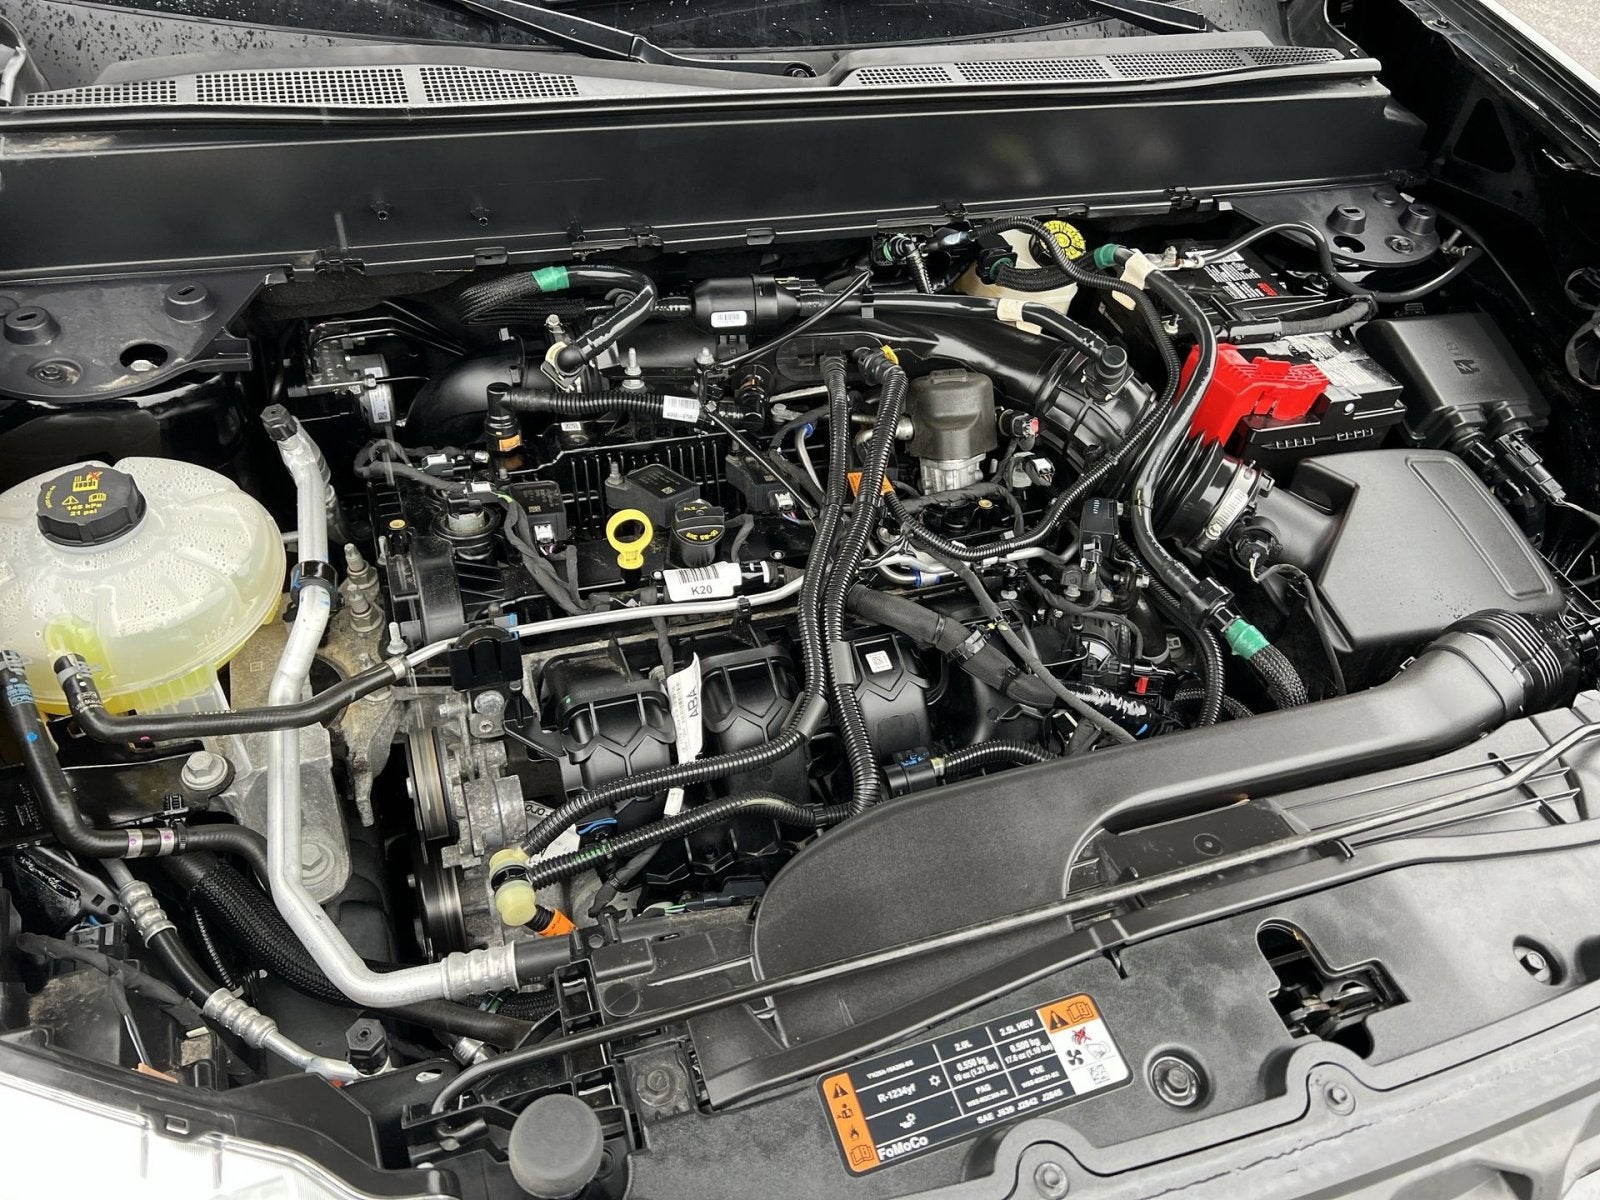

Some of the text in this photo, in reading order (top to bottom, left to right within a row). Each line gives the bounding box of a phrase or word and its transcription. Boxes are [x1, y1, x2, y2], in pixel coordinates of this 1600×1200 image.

[691, 585, 713, 595] K20
[687, 685, 699, 718] ABA
[1016, 1019, 1034, 1030] HEV
[1029, 1038, 1042, 1048] kg
[976, 1056, 988, 1066] kg
[876, 1083, 916, 1102] R-1234yf
[975, 1084, 992, 1094] PAG
[977, 1112, 994, 1123] SAE
[877, 1136, 929, 1160] FoMoCo
